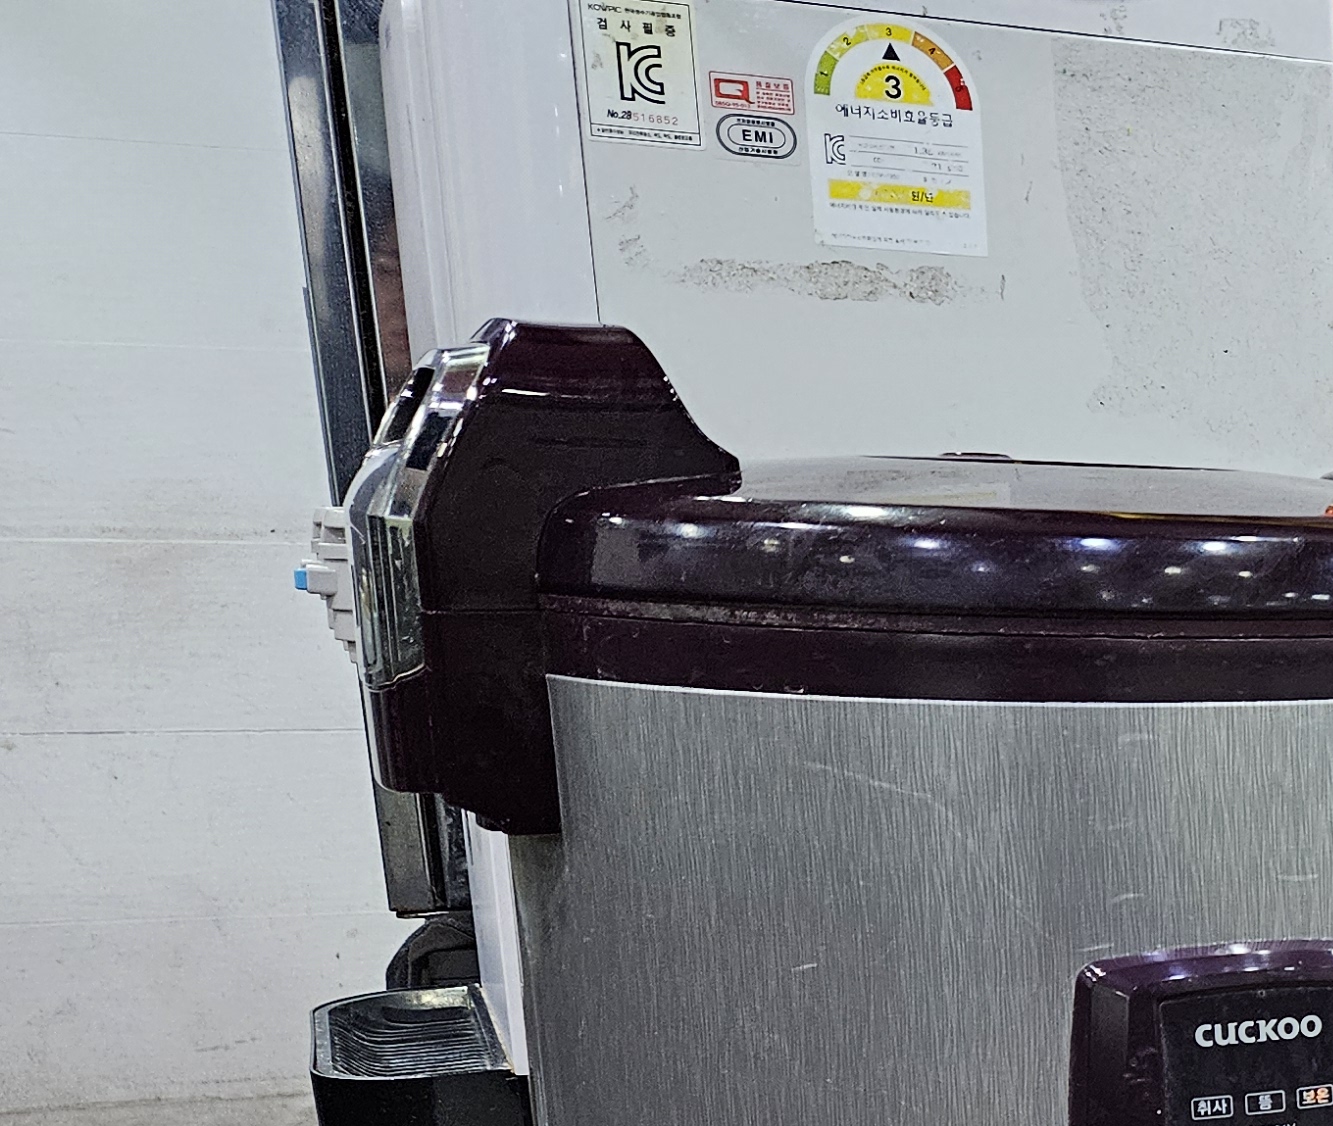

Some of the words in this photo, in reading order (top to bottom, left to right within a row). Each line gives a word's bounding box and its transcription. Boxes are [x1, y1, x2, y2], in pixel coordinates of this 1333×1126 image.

[842, 37, 852, 46] 2
[886, 27, 893, 36] 3
[884, 75, 902, 99] 3
[741, 128, 774, 144] EMI
[1195, 1014, 1322, 1047] CUCKOO
[1197, 1099, 1228, 1116] 취사
[1258, 1095, 1273, 1111] 뜸
[1302, 1087, 1330, 1105] 보온
